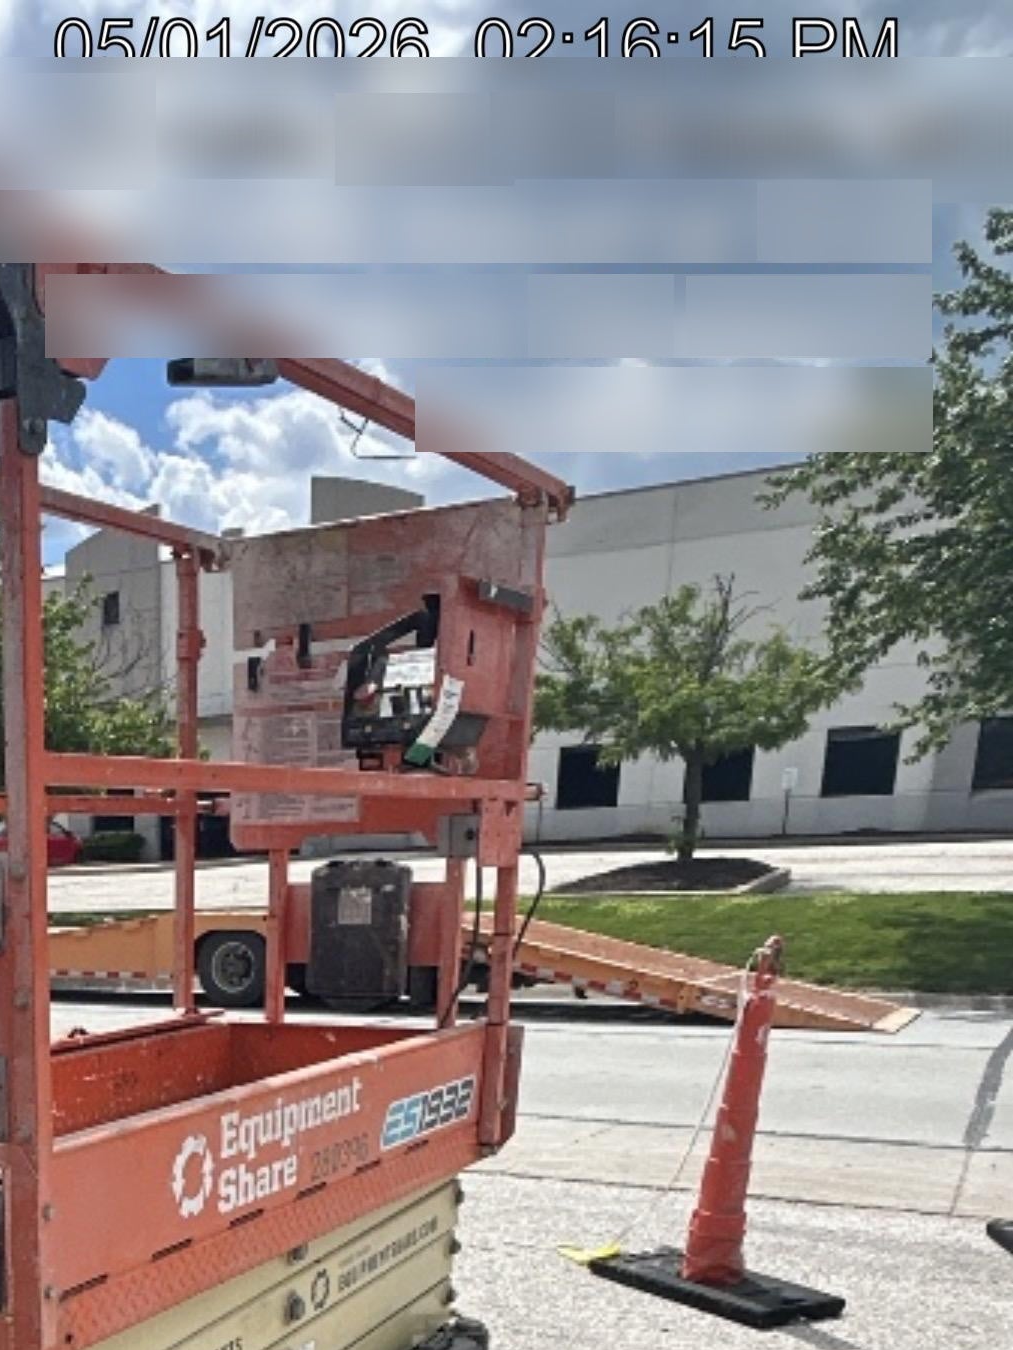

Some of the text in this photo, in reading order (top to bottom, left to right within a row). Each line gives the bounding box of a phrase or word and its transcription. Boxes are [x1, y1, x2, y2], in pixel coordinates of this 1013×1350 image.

[219, 1075, 363, 1160] Equipment
[380, 1074, 476, 1151] ES1932
[216, 1152, 299, 1214] Share
